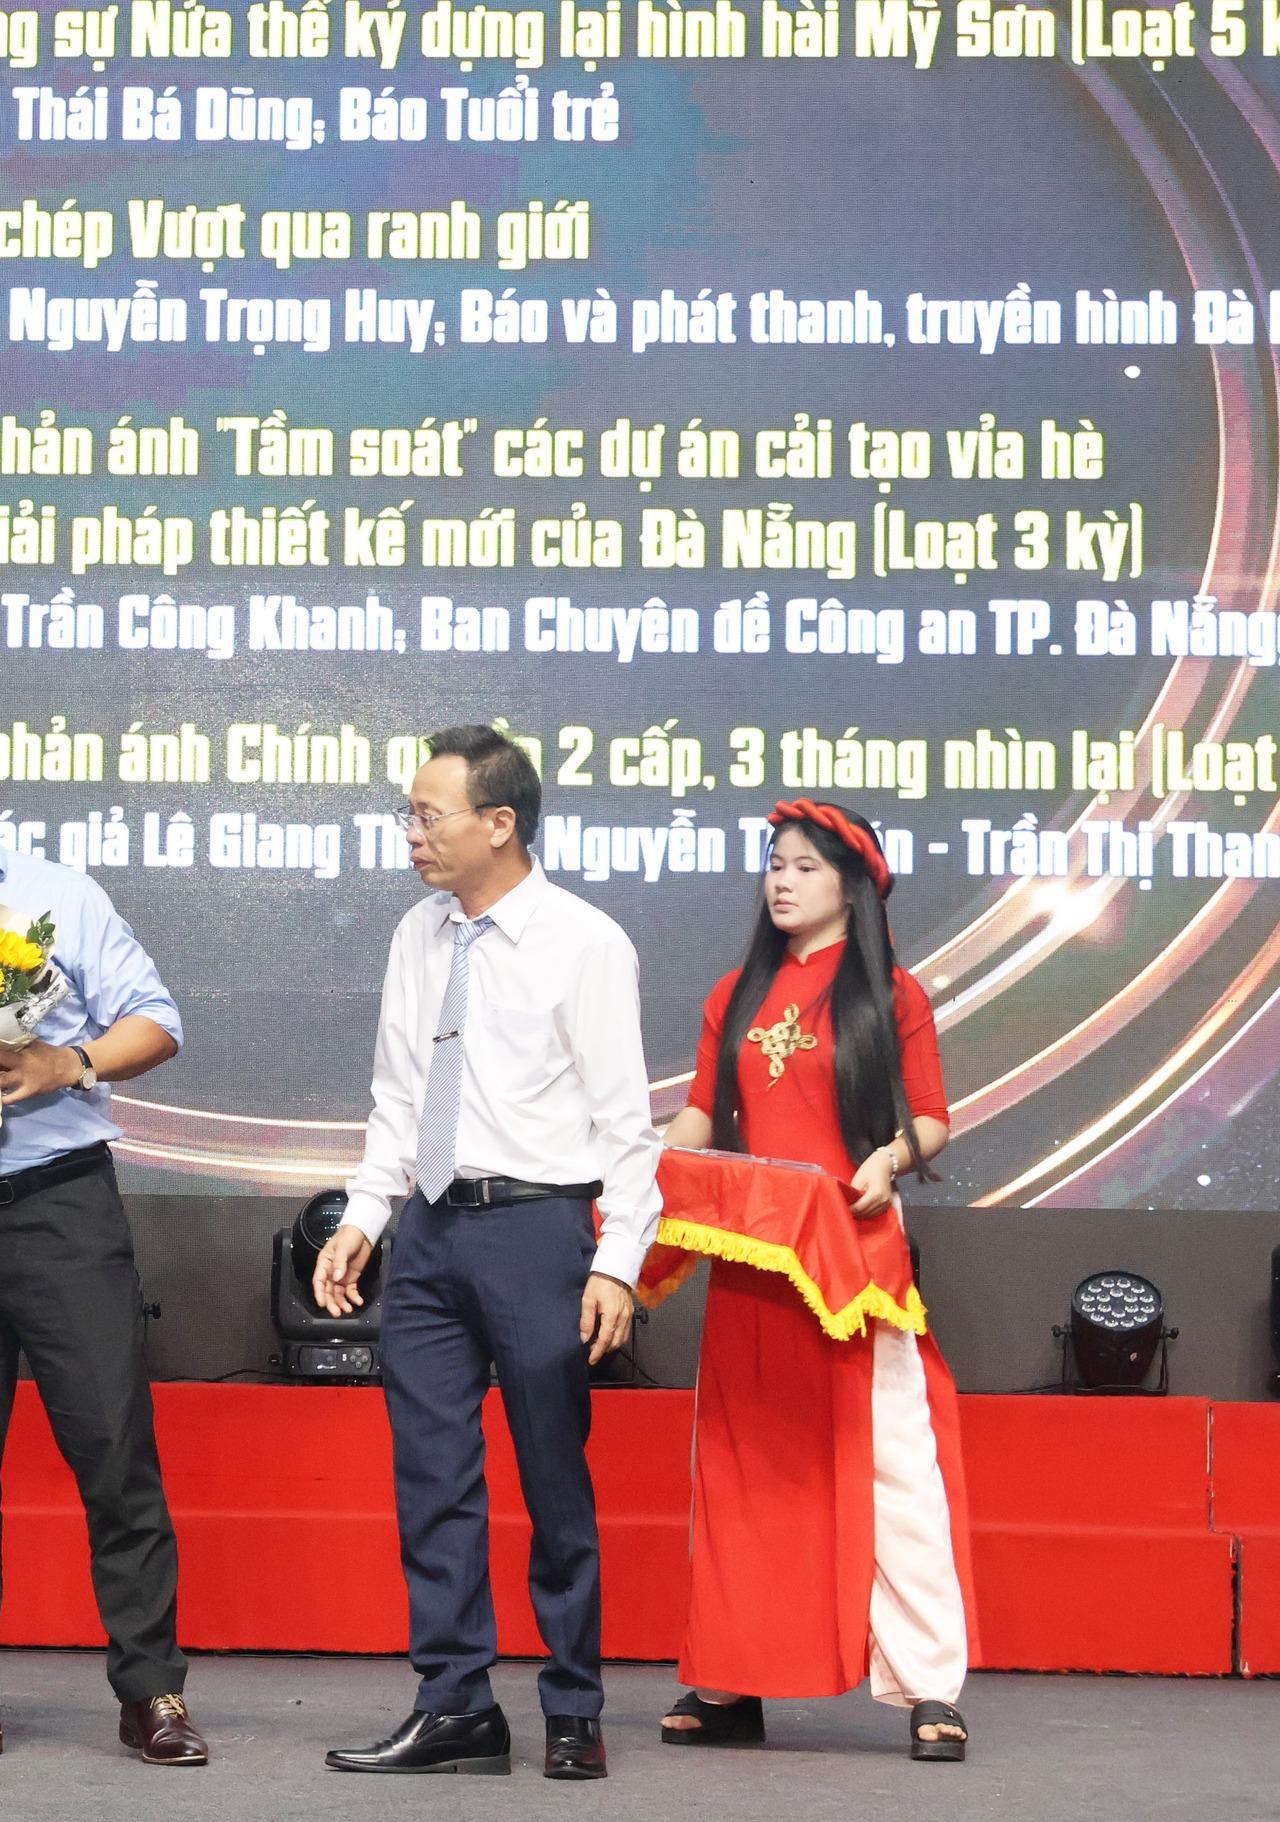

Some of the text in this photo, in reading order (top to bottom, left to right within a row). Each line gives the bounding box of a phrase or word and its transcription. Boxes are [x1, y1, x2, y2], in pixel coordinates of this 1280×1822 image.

[54, 5, 117, 72] sự
[247, 0, 329, 58] thế
[421, 0, 543, 72] dựng
[560, 0, 620, 72] lại
[637, 0, 745, 58] hình
[762, 0, 839, 58] hài
[855, 0, 941, 69] Mỹ
[956, 0, 1054, 57] Sơn
[1071, 0, 1194, 72] (Loạt
[1210, 0, 1245, 57] 5
[12, 85, 109, 141] Thái
[122, 86, 182, 141] Bá
[339, 86, 427, 141] Báo
[440, 74, 539, 142] Tuổi
[551, 81, 619, 142] trẻ
[128, 200, 246, 273] Vượt
[261, 211, 351, 269] qua
[367, 200, 480, 259] ranh
[497, 200, 589, 270] giới
[9, 279, 187, 352] Nguyễn
[199, 288, 330, 356] Trọng
[460, 287, 548, 343] Báo
[561, 287, 617, 343] và
[632, 288, 737, 353] phát
[749, 289, 895, 348] thanh,
[905, 282, 1061, 355] truyền
[1075, 288, 1177, 345] hình
[1192, 289, 1254, 345] Đà
[107, 415, 199, 476] ánh
[493, 417, 583, 477] các
[600, 418, 665, 493] dự
[678, 418, 739, 478] án
[755, 413, 832, 479] cải
[848, 422, 930, 494] tạo
[946, 413, 1023, 479] vỉa
[1041, 419, 1102, 480] hè
[71, 505, 193, 576] pháp
[209, 499, 330, 566] thiết
[344, 499, 415, 566] kế
[422, 507, 515, 567] mới
[531, 502, 622, 568] của
[639, 508, 705, 568] Đà
[722, 502, 855, 580] Nẵng
[874, 502, 998, 585] (Loạt
[1014, 510, 1049, 570] 3
[1066, 502, 1142, 582] kỳ)
[1, 586, 104, 649] Trần
[118, 593, 236, 661] Công
[420, 596, 510, 652] Ban
[524, 596, 699, 663] Chuyên
[713, 591, 770, 653] đề
[785, 597, 904, 664] Công
[918, 609, 976, 655] an
[988, 599, 1062, 655] TP.
[1074, 599, 1136, 656] Đà
[1151, 594, 1280, 667] Nẵng
[118, 721, 211, 783] ánh
[225, 720, 371, 785] Chính
[557, 725, 593, 786] 2
[609, 718, 715, 797] cấp,
[729, 727, 764, 787] 3
[780, 726, 927, 800] tháng
[944, 728, 1055, 790] nhìn
[1072, 730, 1138, 808] lại
[1153, 722, 1277, 807] (Loạt
[60, 805, 130, 875] giả
[142, 809, 195, 869] Lê
[208, 811, 341, 880] Giang
[543, 808, 726, 882] Nguyễn
[961, 813, 1069, 877] Trần
[1079, 819, 1154, 889] Thị
